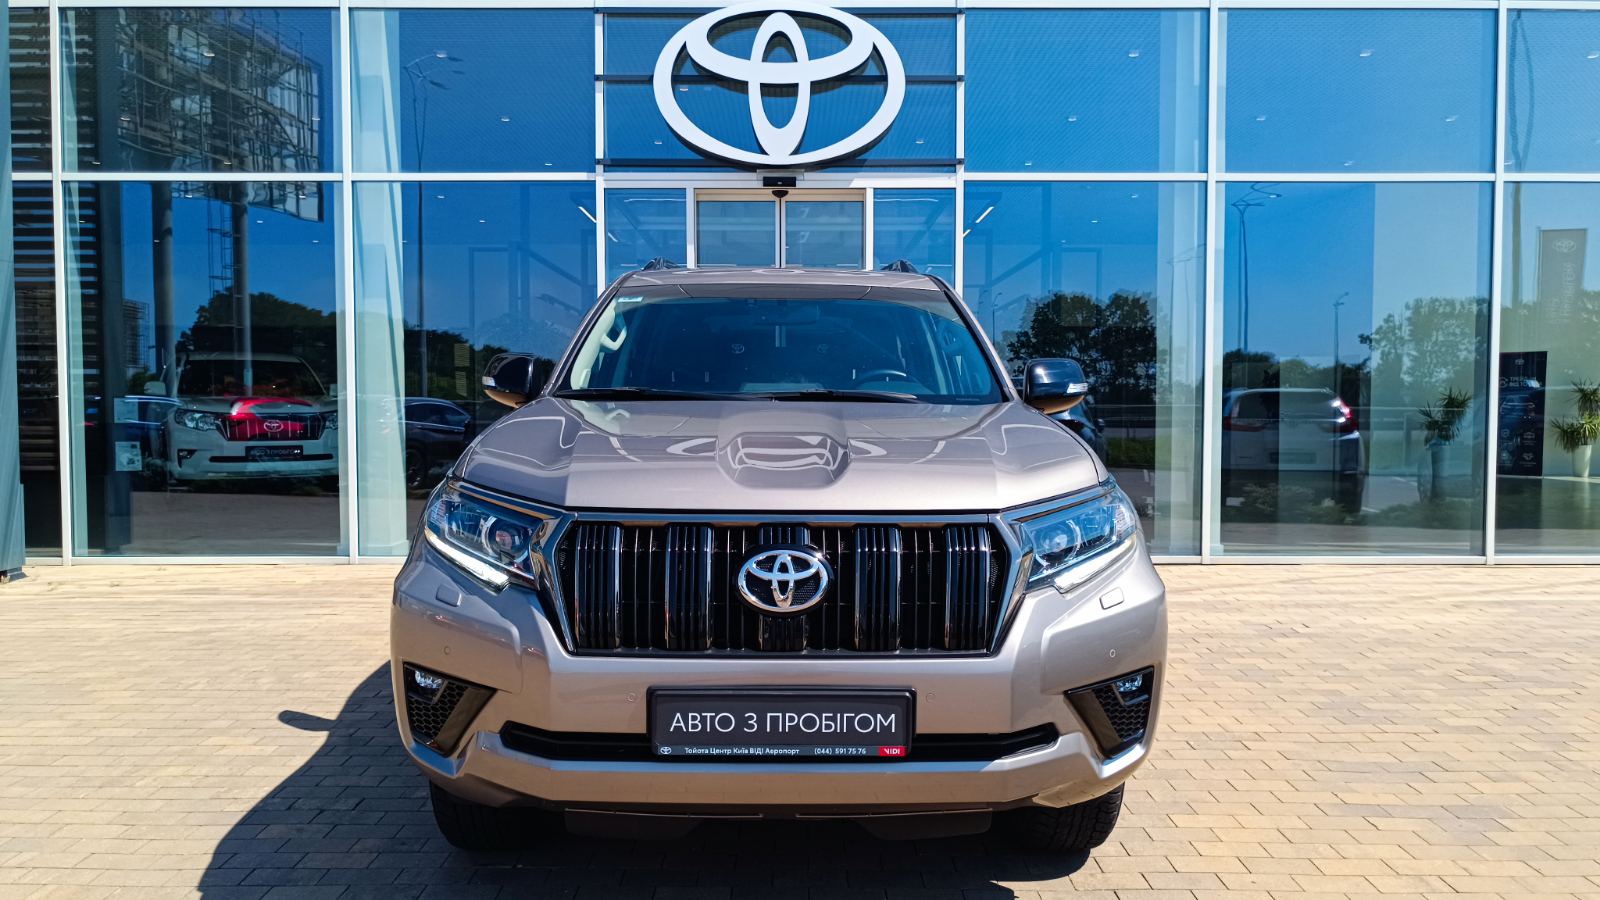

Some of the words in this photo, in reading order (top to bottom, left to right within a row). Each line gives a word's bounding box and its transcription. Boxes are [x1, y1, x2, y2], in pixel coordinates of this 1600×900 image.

[669, 712, 736, 732] АВТО
[766, 712, 897, 733] ПРОБІГОМ
[684, 747, 708, 755] Тойота
[709, 747, 732, 756] Центр
[764, 747, 800, 756] Аеропорт
[814, 747, 833, 756] (044)
